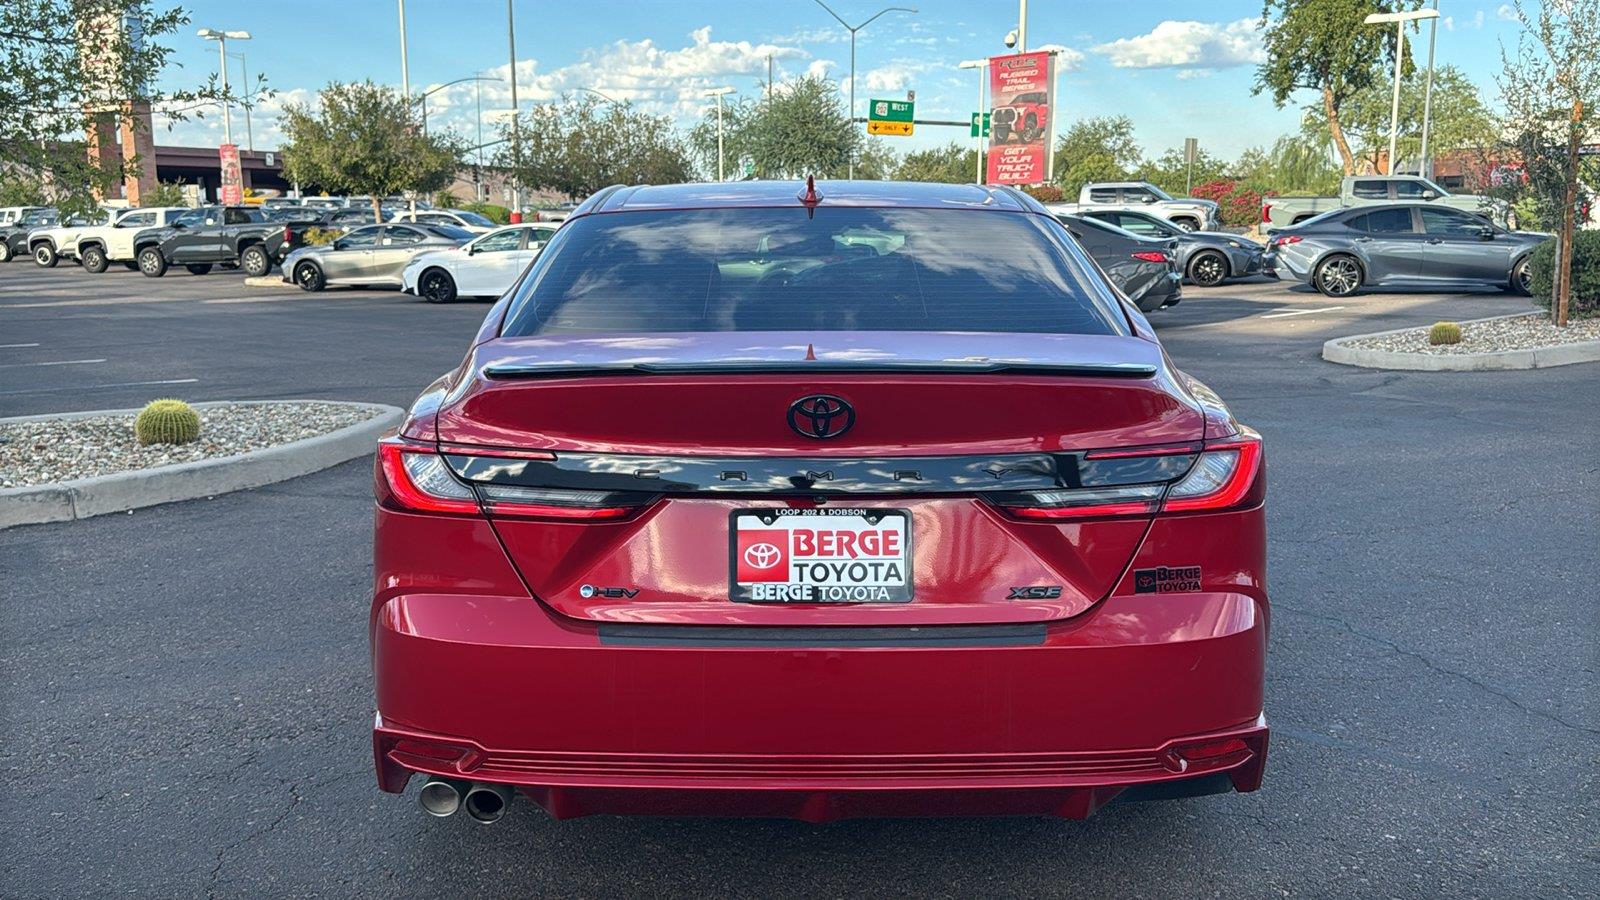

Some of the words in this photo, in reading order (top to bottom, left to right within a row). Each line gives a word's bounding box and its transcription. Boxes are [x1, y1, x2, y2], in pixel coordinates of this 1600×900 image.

[999, 69, 1039, 80] RUGGED
[1006, 77, 1031, 85] TRAIL
[1001, 83, 1036, 93] SERIES
[891, 102, 909, 112] WEST
[1004, 147, 1028, 156] GET
[1000, 155, 1033, 164] YOUR
[997, 163, 1035, 172] TRUCK
[633, 468, 1013, 482] CAMRY
[775, 508, 800, 516] LOOP
[802, 508, 818, 516] 202
[820, 508, 826, 516] &
[828, 508, 867, 516] DOBSON
[792, 529, 900, 559] BERGE
[793, 562, 903, 583] TOYOTA
[1157, 567, 1201, 582] BERGE
[1157, 581, 1201, 592] TOYOTA
[751, 584, 813, 602] BERGE
[818, 586, 890, 601] TOYOTA
[1007, 586, 1063, 600] XSE
